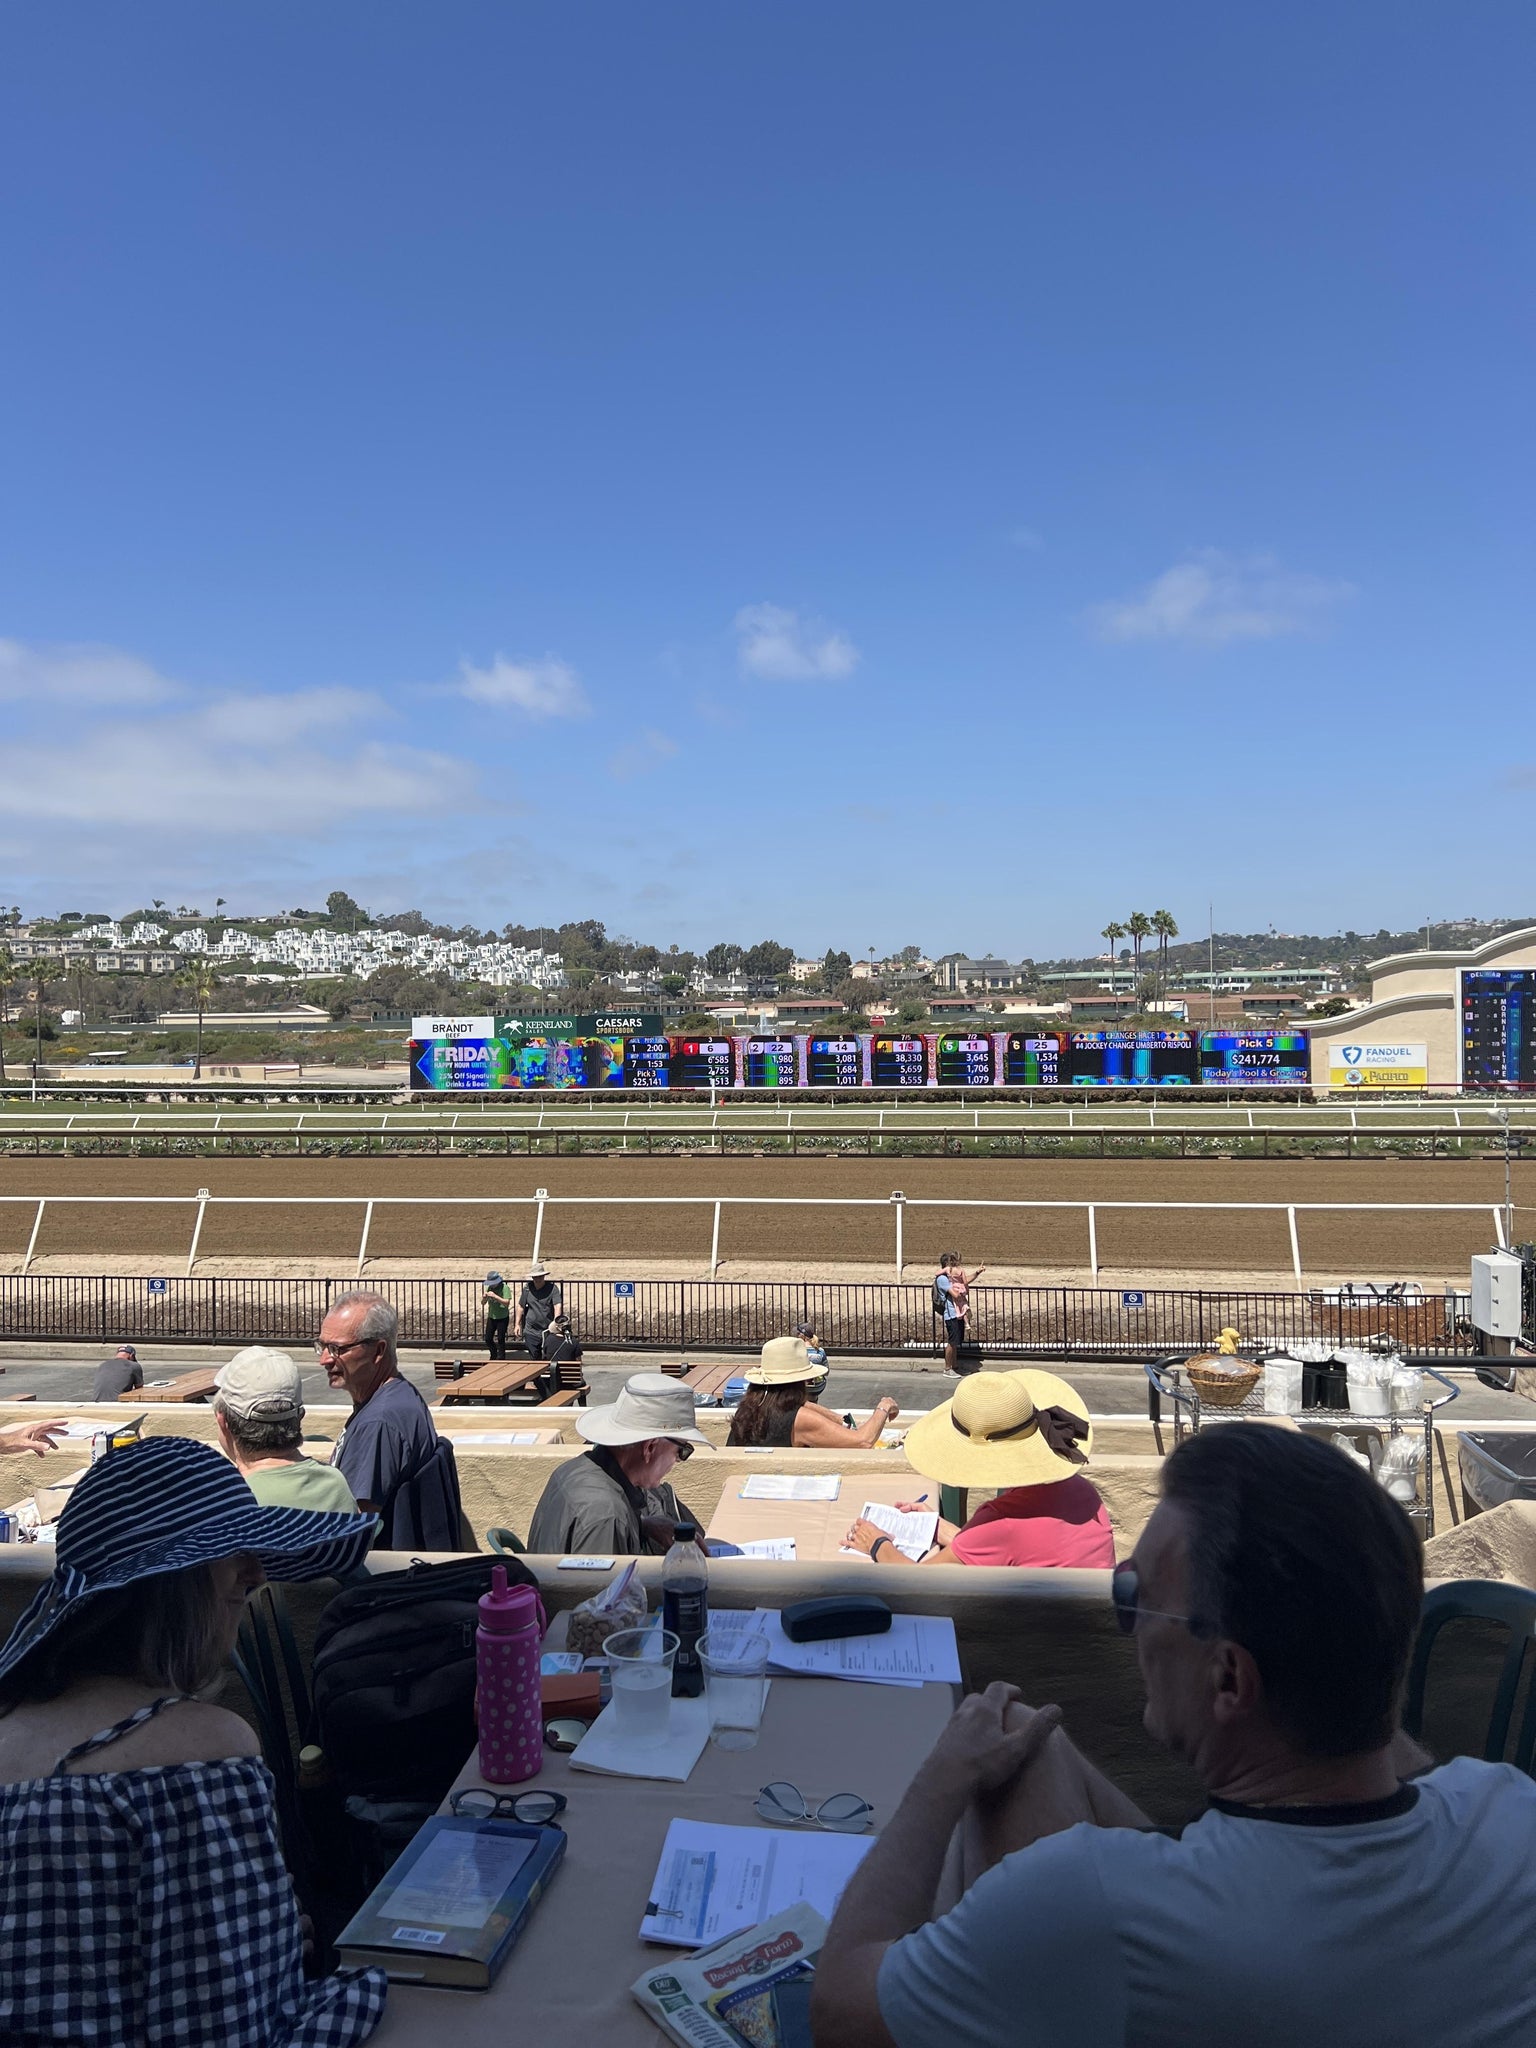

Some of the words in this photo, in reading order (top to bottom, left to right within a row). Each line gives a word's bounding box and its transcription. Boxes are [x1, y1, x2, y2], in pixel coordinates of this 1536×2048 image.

[525, 1020, 573, 1029] KEENELAND
[596, 1018, 642, 1028] CAESARS
[432, 1024, 474, 1033] BRANDT
[1105, 1031, 1137, 1040] CHANGES
[632, 1044, 636, 1052] 1
[646, 1044, 663, 1052] 2:00
[753, 1044, 759, 1052] 2
[772, 1044, 784, 1052] 22
[817, 1043, 823, 1051] 3
[835, 1043, 848, 1051] 14
[880, 1043, 887, 1051] 4
[899, 1042, 914, 1051] 1/5
[946, 1042, 953, 1051] 5
[967, 1042, 978, 1050] 11
[1013, 1041, 1021, 1050] 6
[1034, 1041, 1048, 1049] 25
[1075, 1041, 1084, 1049] #4
[1085, 1041, 1107, 1049] JOCKEY
[1108, 1041, 1135, 1049] CHANGE
[1136, 1041, 1167, 1049] UMBERTO
[1167, 1040, 1192, 1049] RISPOLI
[1238, 1039, 1263, 1048] Pick
[1266, 1039, 1273, 1048] 5
[688, 1045, 694, 1053] 1
[708, 1045, 714, 1053] 6
[434, 1047, 501, 1061] FRIDAY
[835, 1054, 857, 1063] 3,081
[895, 1054, 923, 1063] 38,330
[966, 1053, 989, 1062] 3,645
[1036, 1053, 1058, 1062] 1,534
[632, 1060, 637, 1068] 7
[647, 1060, 663, 1068] 1:53
[771, 1055, 793, 1064] 1,980
[1232, 1054, 1280, 1065] $241,774
[708, 1066, 729, 1074] 2755
[778, 1066, 793, 1074] 926
[836, 1066, 857, 1074] 1,684
[900, 1065, 923, 1073] 5,659
[967, 1065, 989, 1073] 1,706
[1042, 1064, 1058, 1073] 941
[466, 1073, 496, 1081] Signature
[1240, 1069, 1259, 1077] Pool
[1261, 1069, 1268, 1077] &
[1270, 1069, 1308, 1079] Growing
[633, 1078, 662, 1087] $25,141
[709, 1077, 730, 1086] 1513
[778, 1077, 793, 1085] 895
[836, 1076, 857, 1085] 1,011
[900, 1076, 923, 1085] 8,555
[967, 1075, 990, 1084] 1,079
[1042, 1075, 1059, 1084] 935
[709, 1964, 746, 1982] Racing
[764, 1939, 794, 1959] Form
